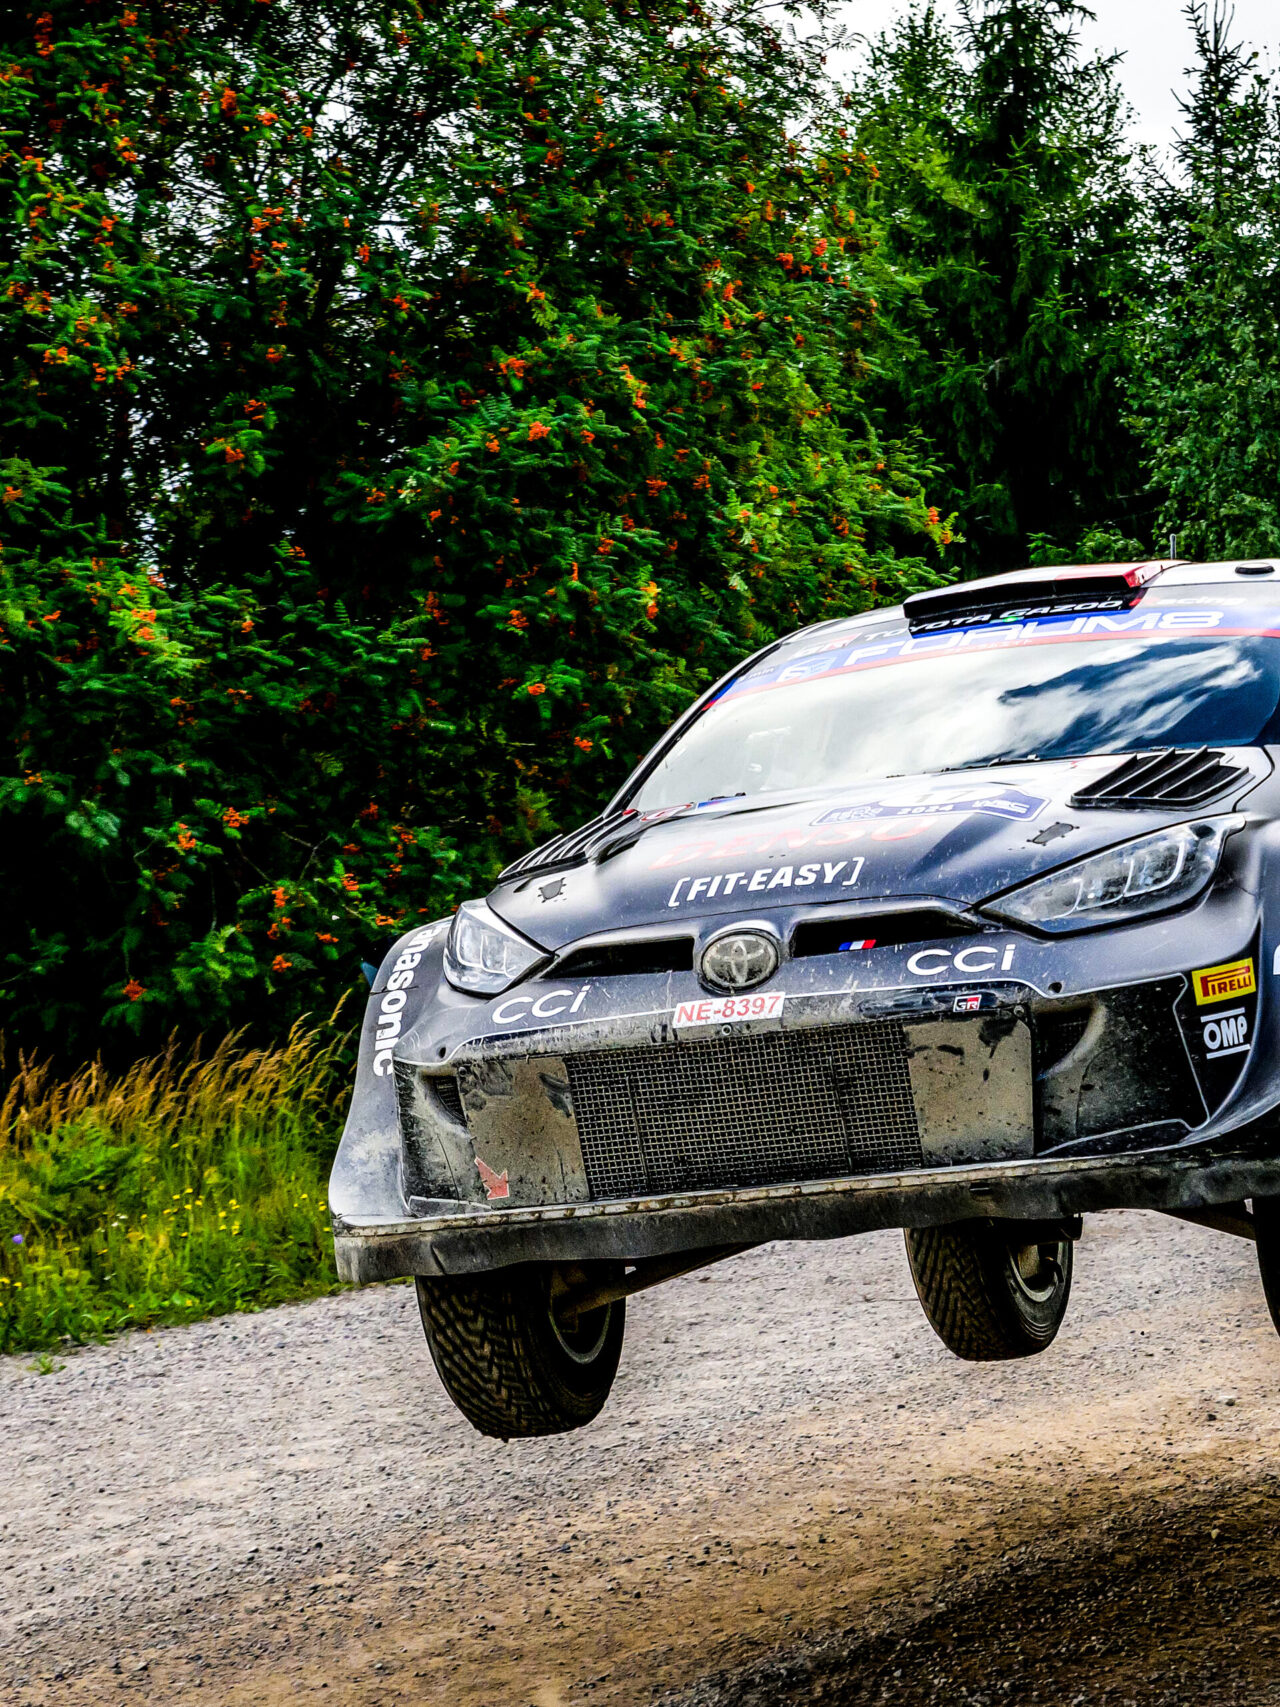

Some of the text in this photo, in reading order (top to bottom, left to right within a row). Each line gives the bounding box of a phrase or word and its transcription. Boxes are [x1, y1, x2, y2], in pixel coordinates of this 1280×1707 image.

[865, 613, 992, 642] TOYOTA
[1000, 600, 1123, 618] GAZOO
[843, 611, 1224, 667] FORUM8
[897, 804, 954, 815] 2024
[1200, 966, 1252, 997] PIRELLI
[676, 996, 781, 1023] NE-8397
[955, 999, 979, 1011] GR
[1203, 1015, 1247, 1050] OMP
